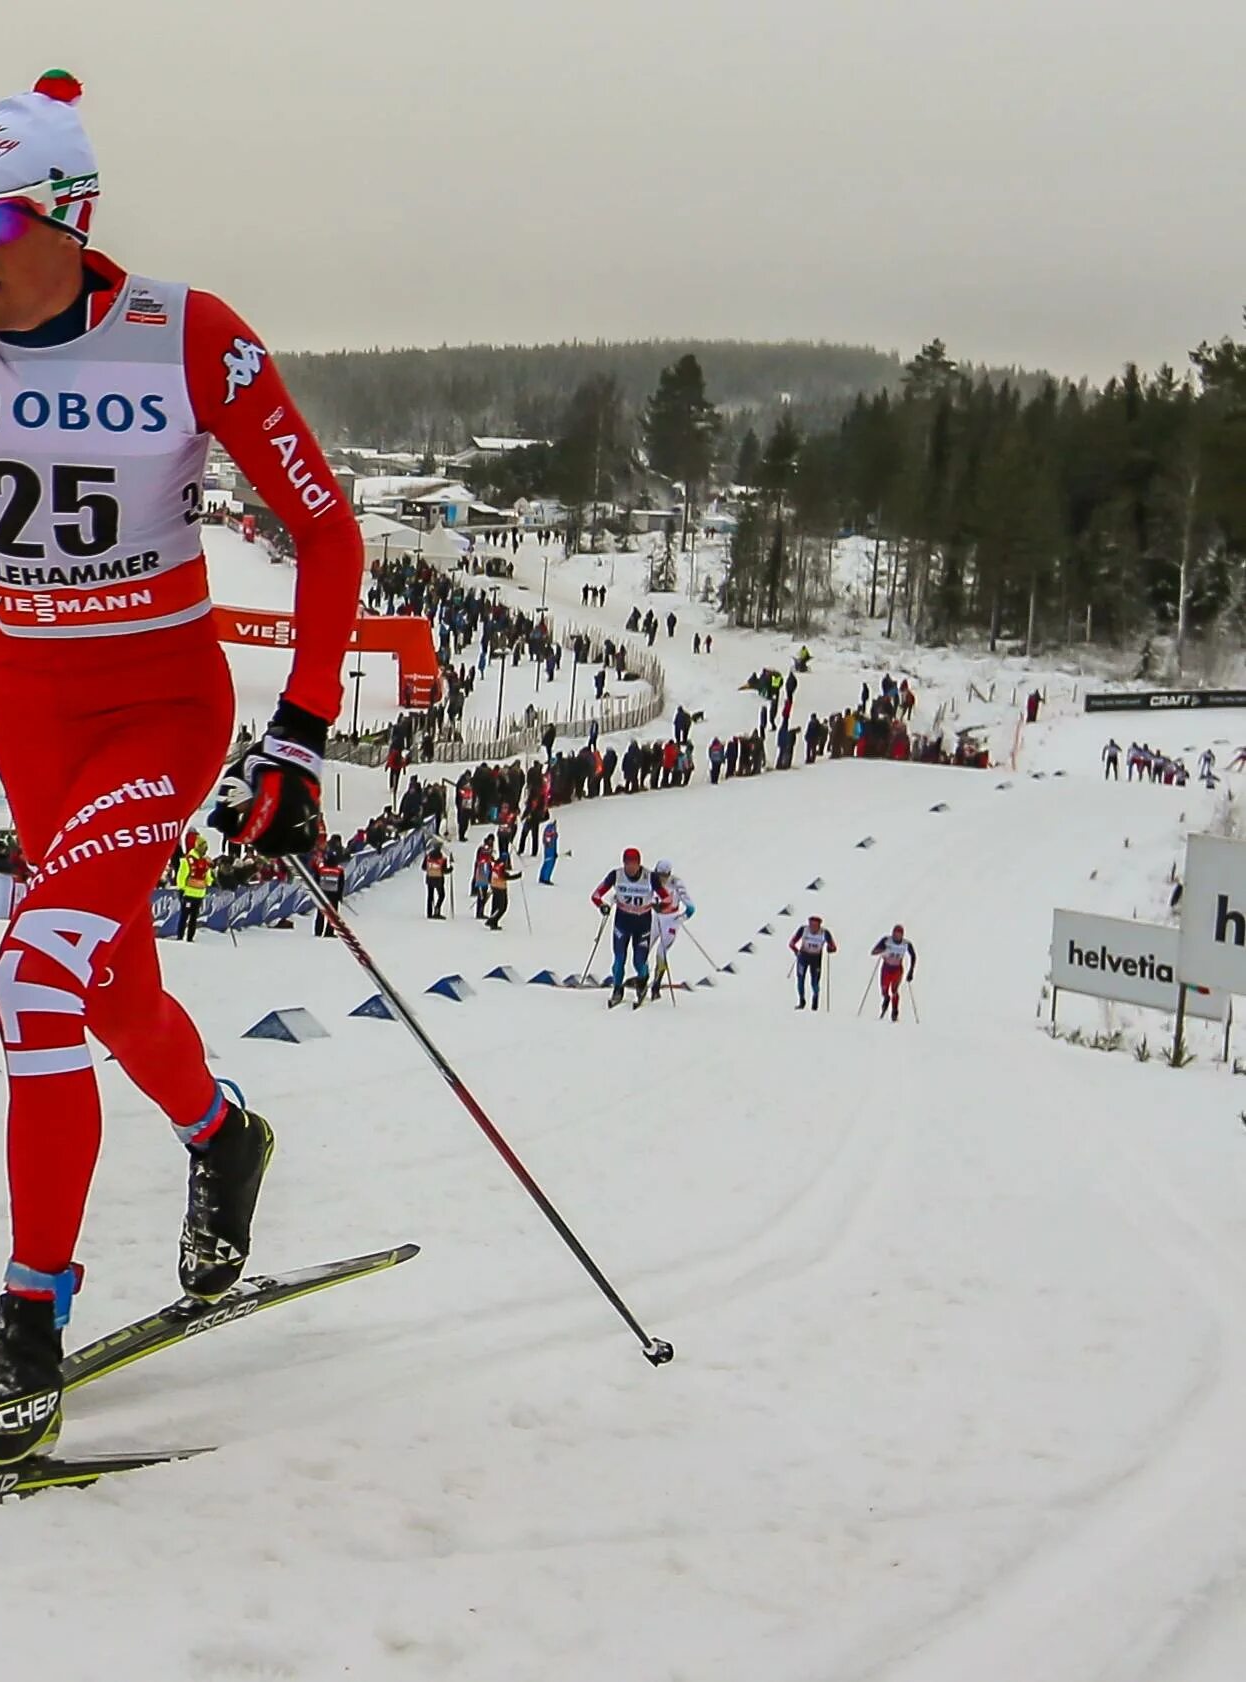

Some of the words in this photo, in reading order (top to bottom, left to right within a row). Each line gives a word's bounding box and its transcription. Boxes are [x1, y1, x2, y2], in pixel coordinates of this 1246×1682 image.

[13, 391, 167, 432] OBOS
[270, 434, 337, 518] Audi
[1150, 694, 1191, 707] CRAFT
[65, 775, 175, 832] sportful
[1068, 939, 1174, 983] helvetia
[184, 1300, 259, 1337] FISCHER
